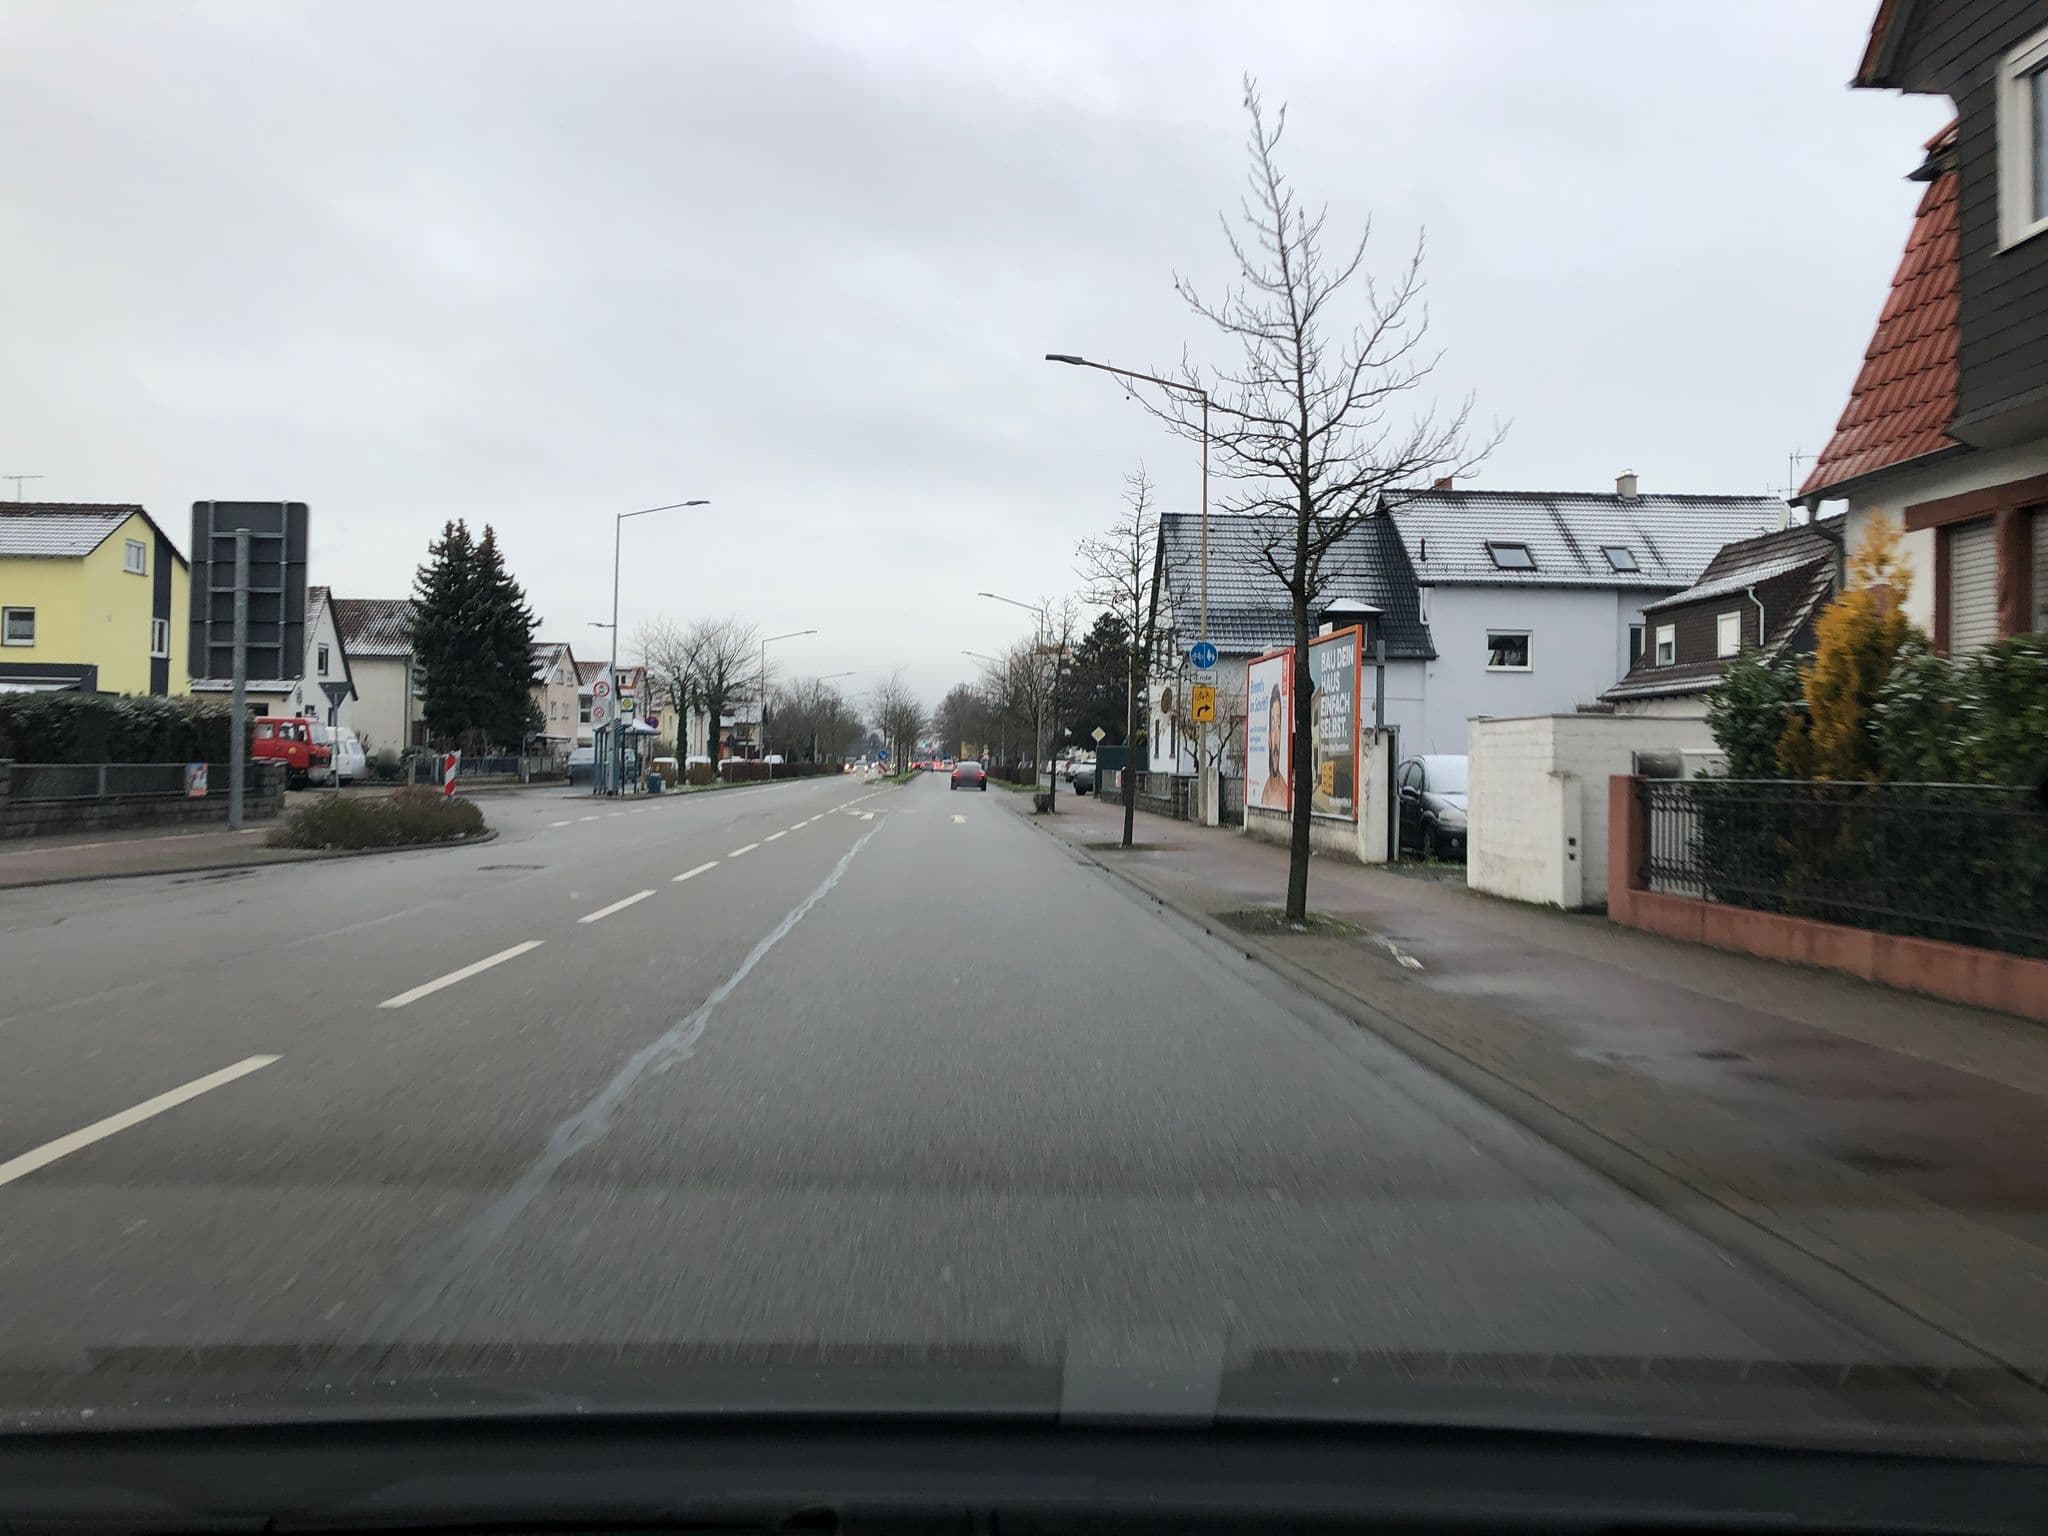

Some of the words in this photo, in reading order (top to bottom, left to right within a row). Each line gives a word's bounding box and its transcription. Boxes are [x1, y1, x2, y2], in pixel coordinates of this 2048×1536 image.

[1321, 650, 1336, 672] BAU
[1336, 644, 1354, 668] DEIN
[1321, 671, 1340, 695] HAUS
[1320, 692, 1350, 717] EINFACH
